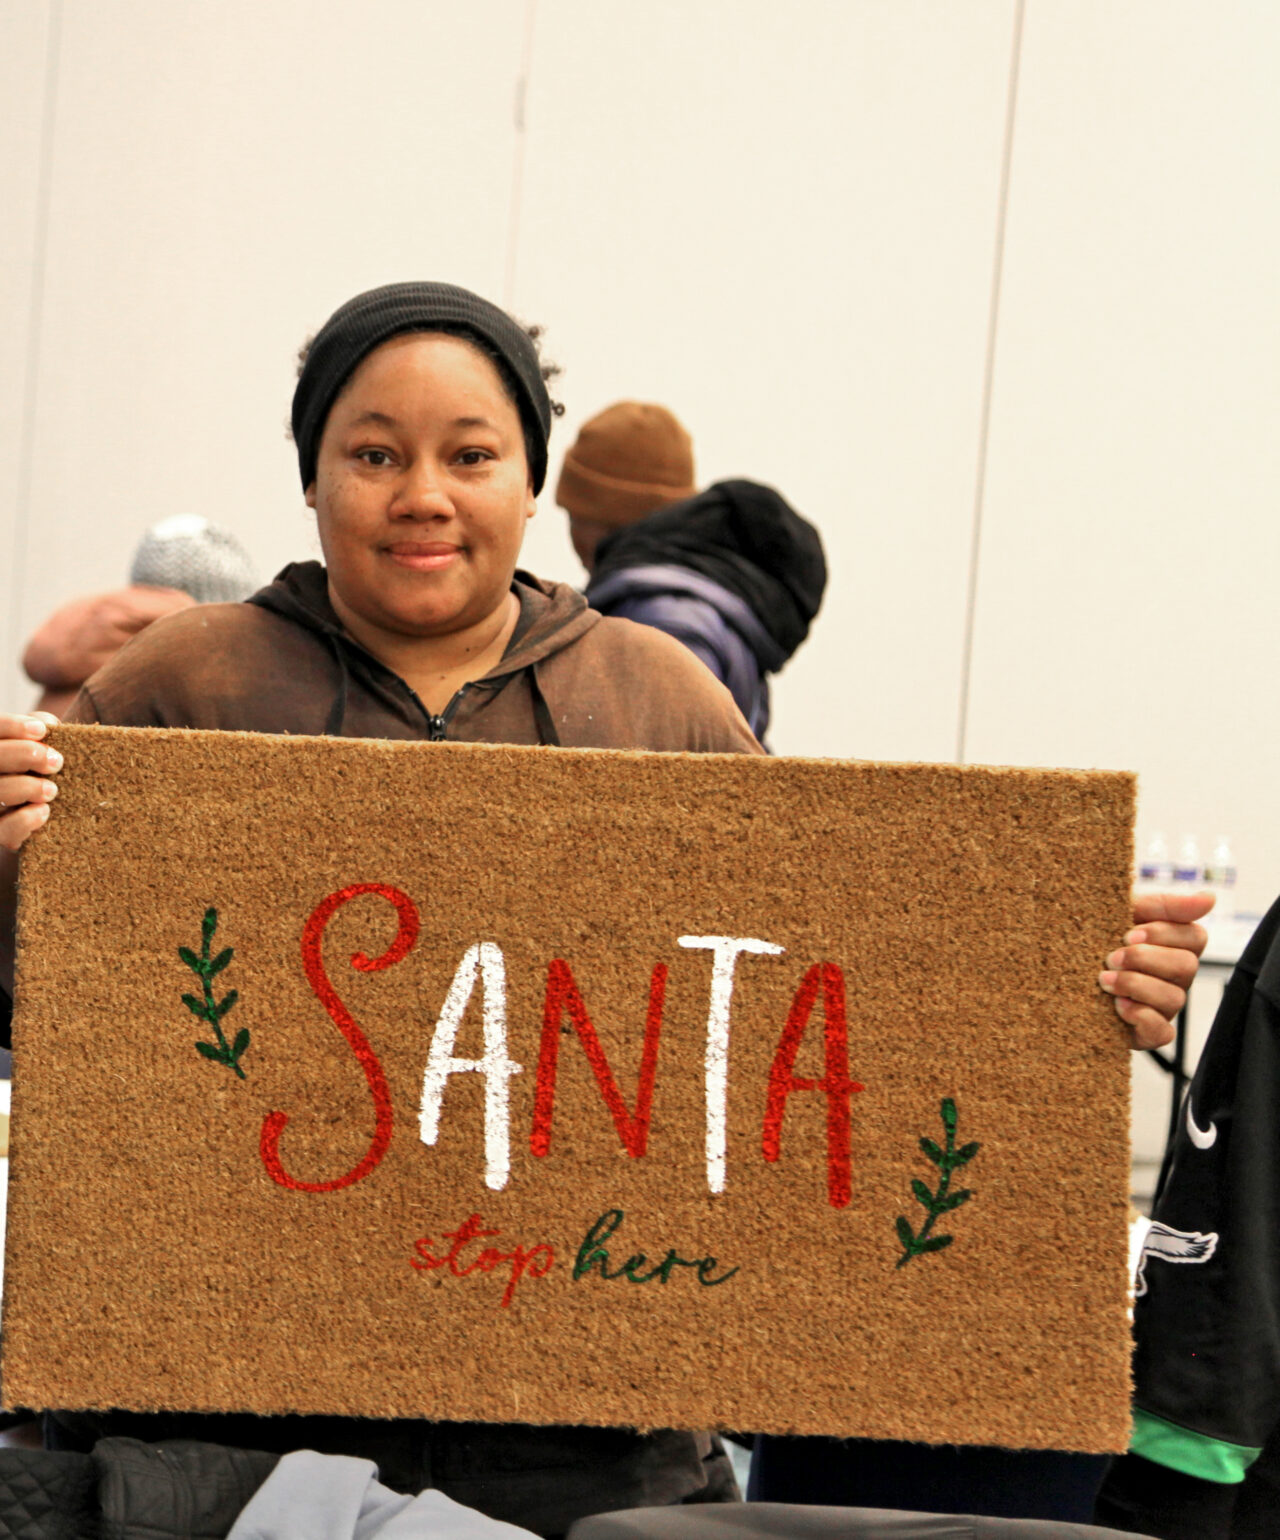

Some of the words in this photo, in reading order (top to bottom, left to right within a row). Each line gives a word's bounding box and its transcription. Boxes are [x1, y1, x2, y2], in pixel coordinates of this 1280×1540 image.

[259, 882, 865, 1208] SANTA
[410, 1213, 554, 1308] stop
[573, 1209, 740, 1287] here
